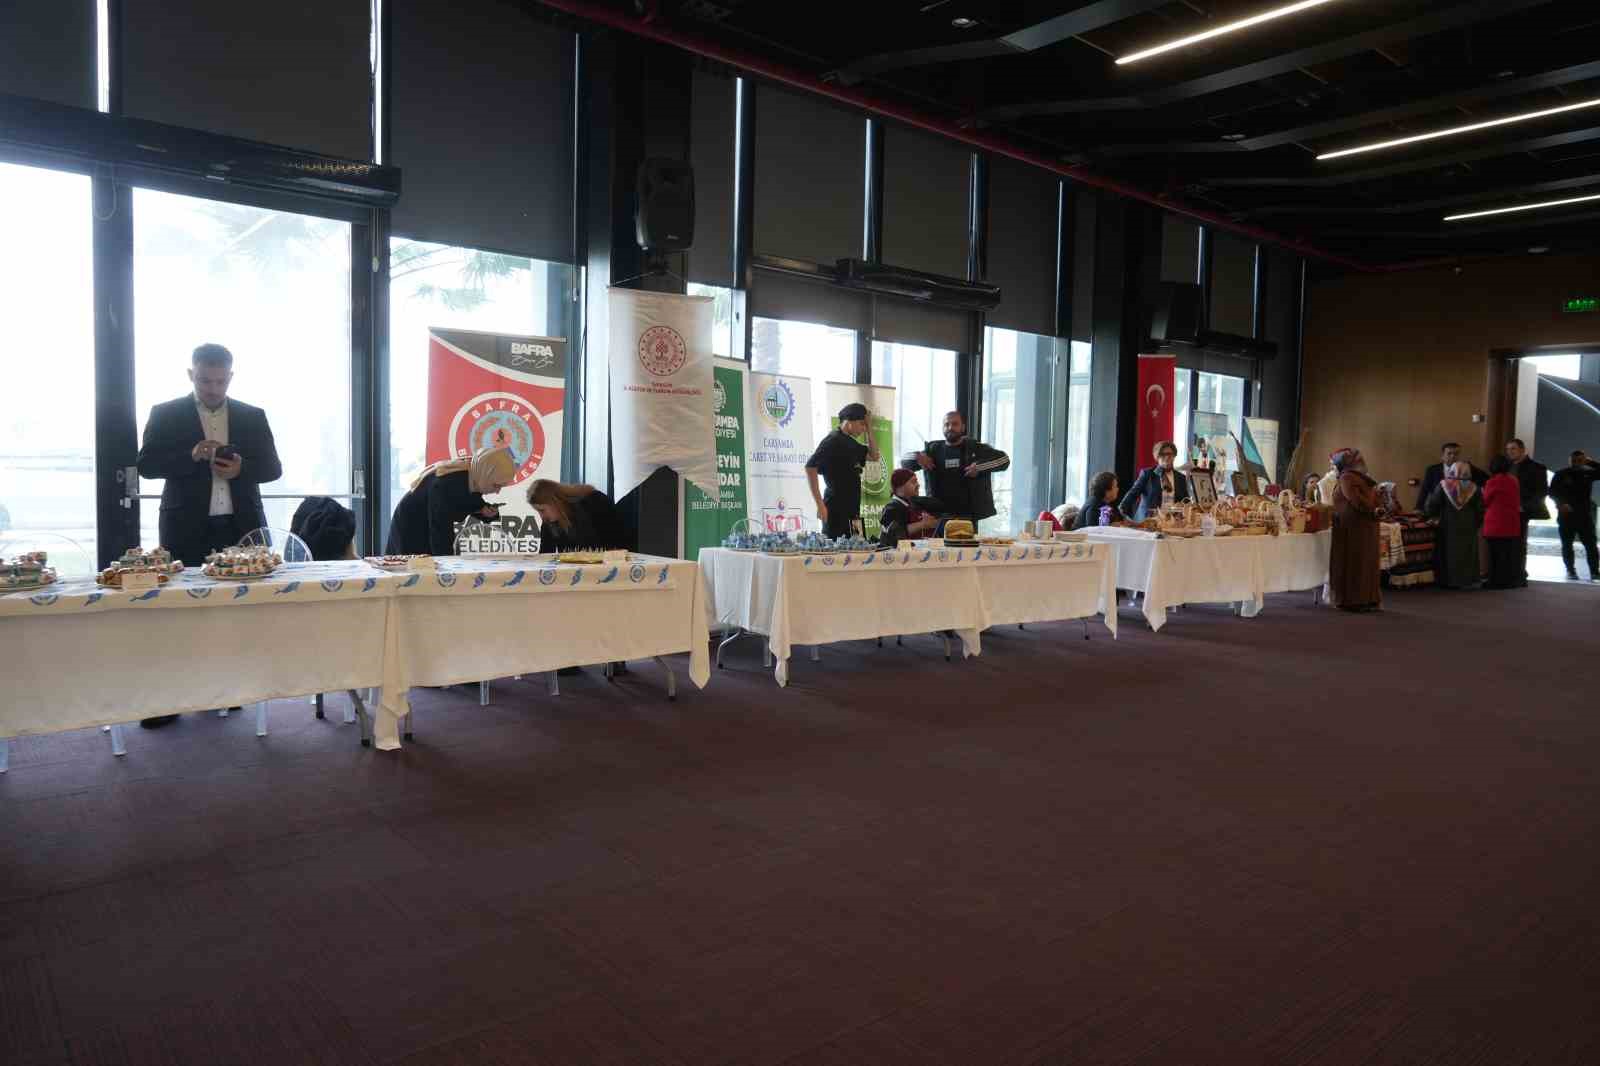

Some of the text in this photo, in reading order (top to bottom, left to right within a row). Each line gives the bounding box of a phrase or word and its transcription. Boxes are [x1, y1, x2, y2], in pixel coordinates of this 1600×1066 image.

[511, 342, 554, 357] BAFRA
[472, 400, 531, 421] BAFRA
[718, 451, 740, 468] EYİN
[719, 473, 740, 486] DAR
[459, 539, 539, 553] ELEDİYES
